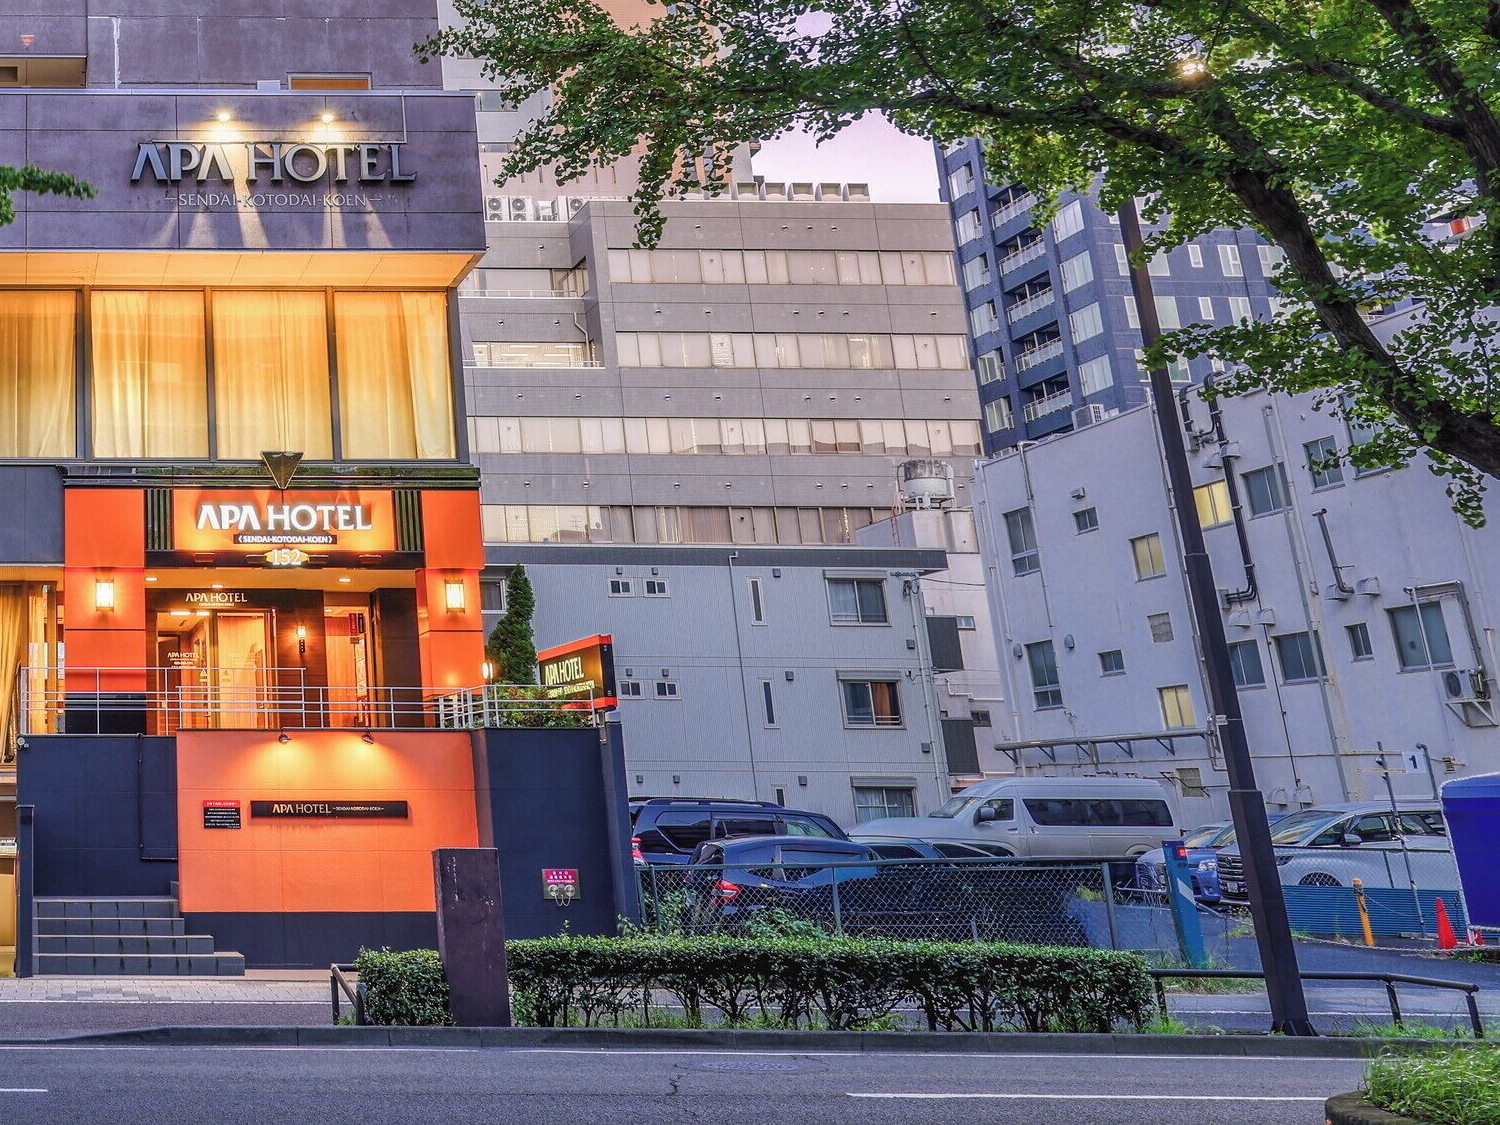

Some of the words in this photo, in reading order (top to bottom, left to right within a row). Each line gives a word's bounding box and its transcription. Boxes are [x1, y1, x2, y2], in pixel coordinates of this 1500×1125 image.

[130, 142, 234, 182] APA
[245, 142, 417, 182] HOTEL
[196, 505, 261, 531] APA
[266, 505, 372, 531] HOTEL
[271, 548, 302, 566] 152
[185, 592, 208, 603] APA
[210, 592, 248, 603] HOTEL
[544, 662, 560, 686] APA
[558, 656, 585, 684] HOTEL
[1408, 755, 1418, 769] 1
[272, 803, 294, 814] APA
[295, 803, 332, 814] HOTEL
